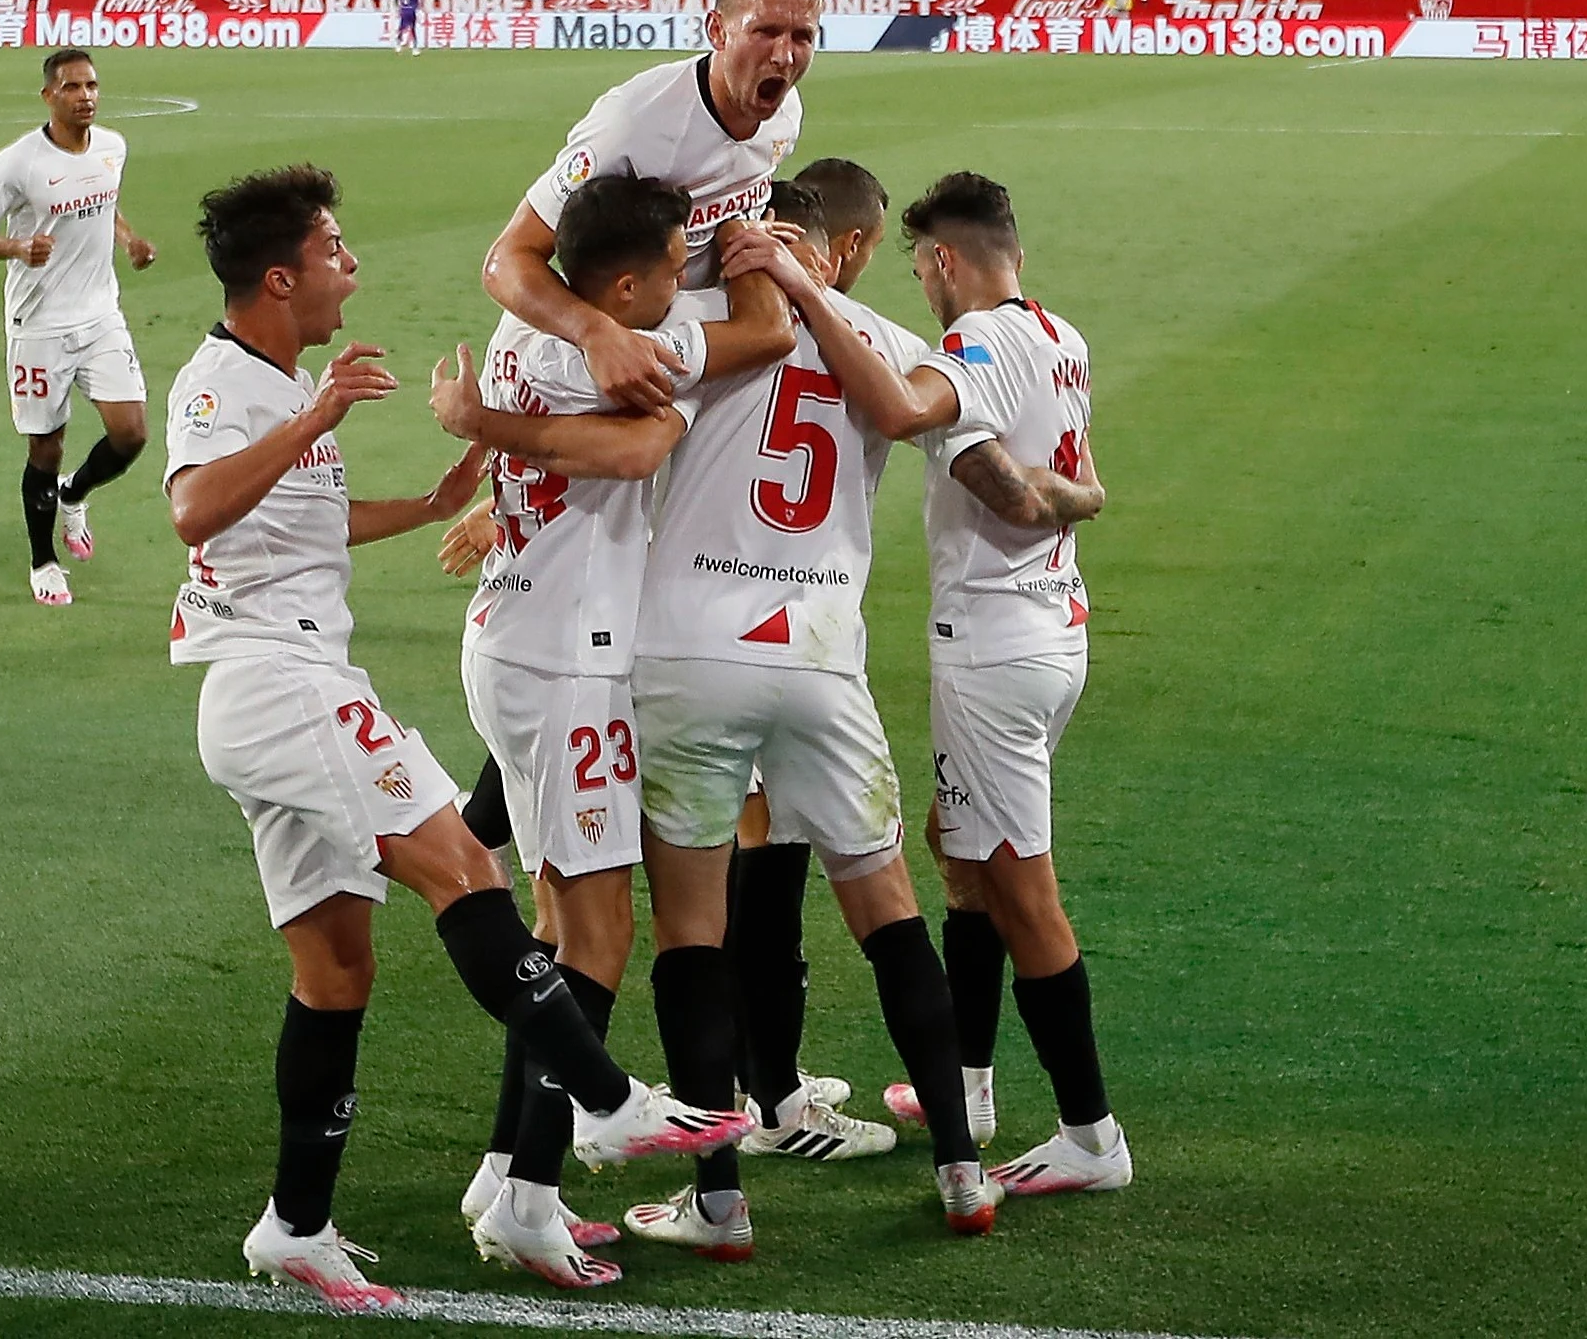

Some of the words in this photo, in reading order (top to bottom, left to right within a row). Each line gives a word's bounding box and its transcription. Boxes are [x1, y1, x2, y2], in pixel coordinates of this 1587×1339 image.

[34, 10, 302, 49] Mabo138.com
[1091, 17, 1384, 58] Mabo138.com
[77, 204, 103, 220] BET
[14, 364, 50, 400] 25
[748, 363, 842, 536] 5
[568, 717, 640, 794] 23
